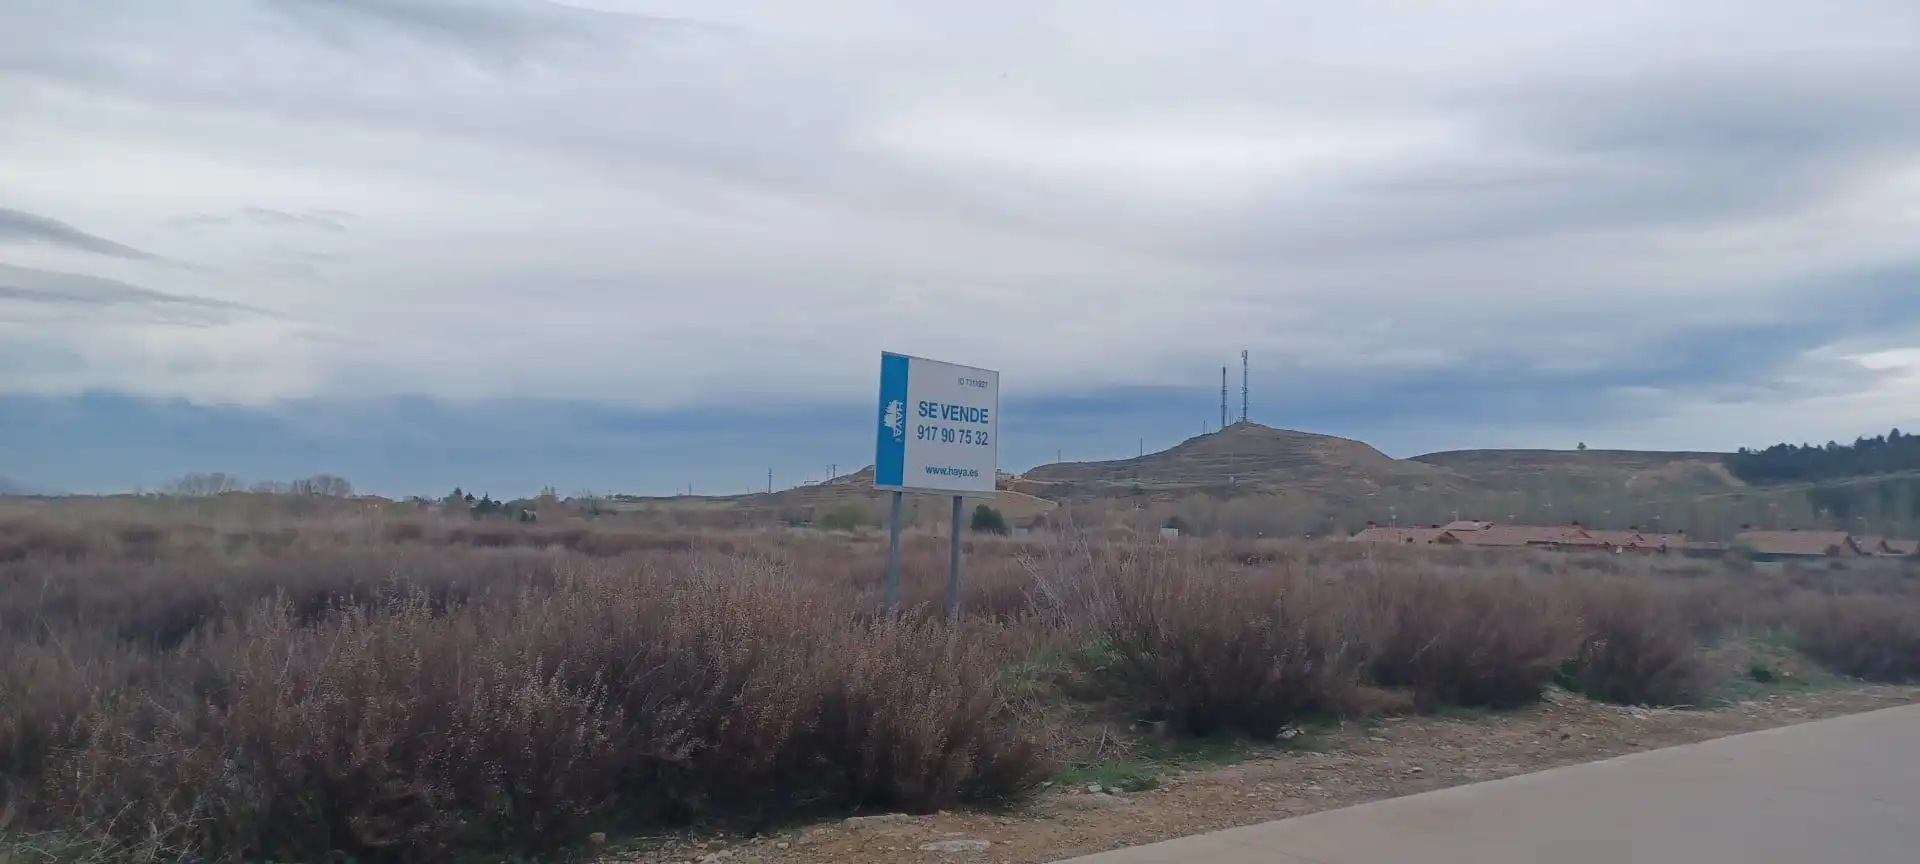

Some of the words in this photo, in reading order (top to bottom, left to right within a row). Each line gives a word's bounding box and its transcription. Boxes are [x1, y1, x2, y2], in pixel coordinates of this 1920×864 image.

[894, 400, 903, 437] HAYA
[918, 400, 938, 418] SE
[941, 403, 988, 424] VENDE
[917, 425, 938, 440] 917
[941, 428, 955, 443] 90
[959, 430, 972, 444] 75
[975, 432, 988, 446] 32
[926, 466, 979, 478] www.haya.es
